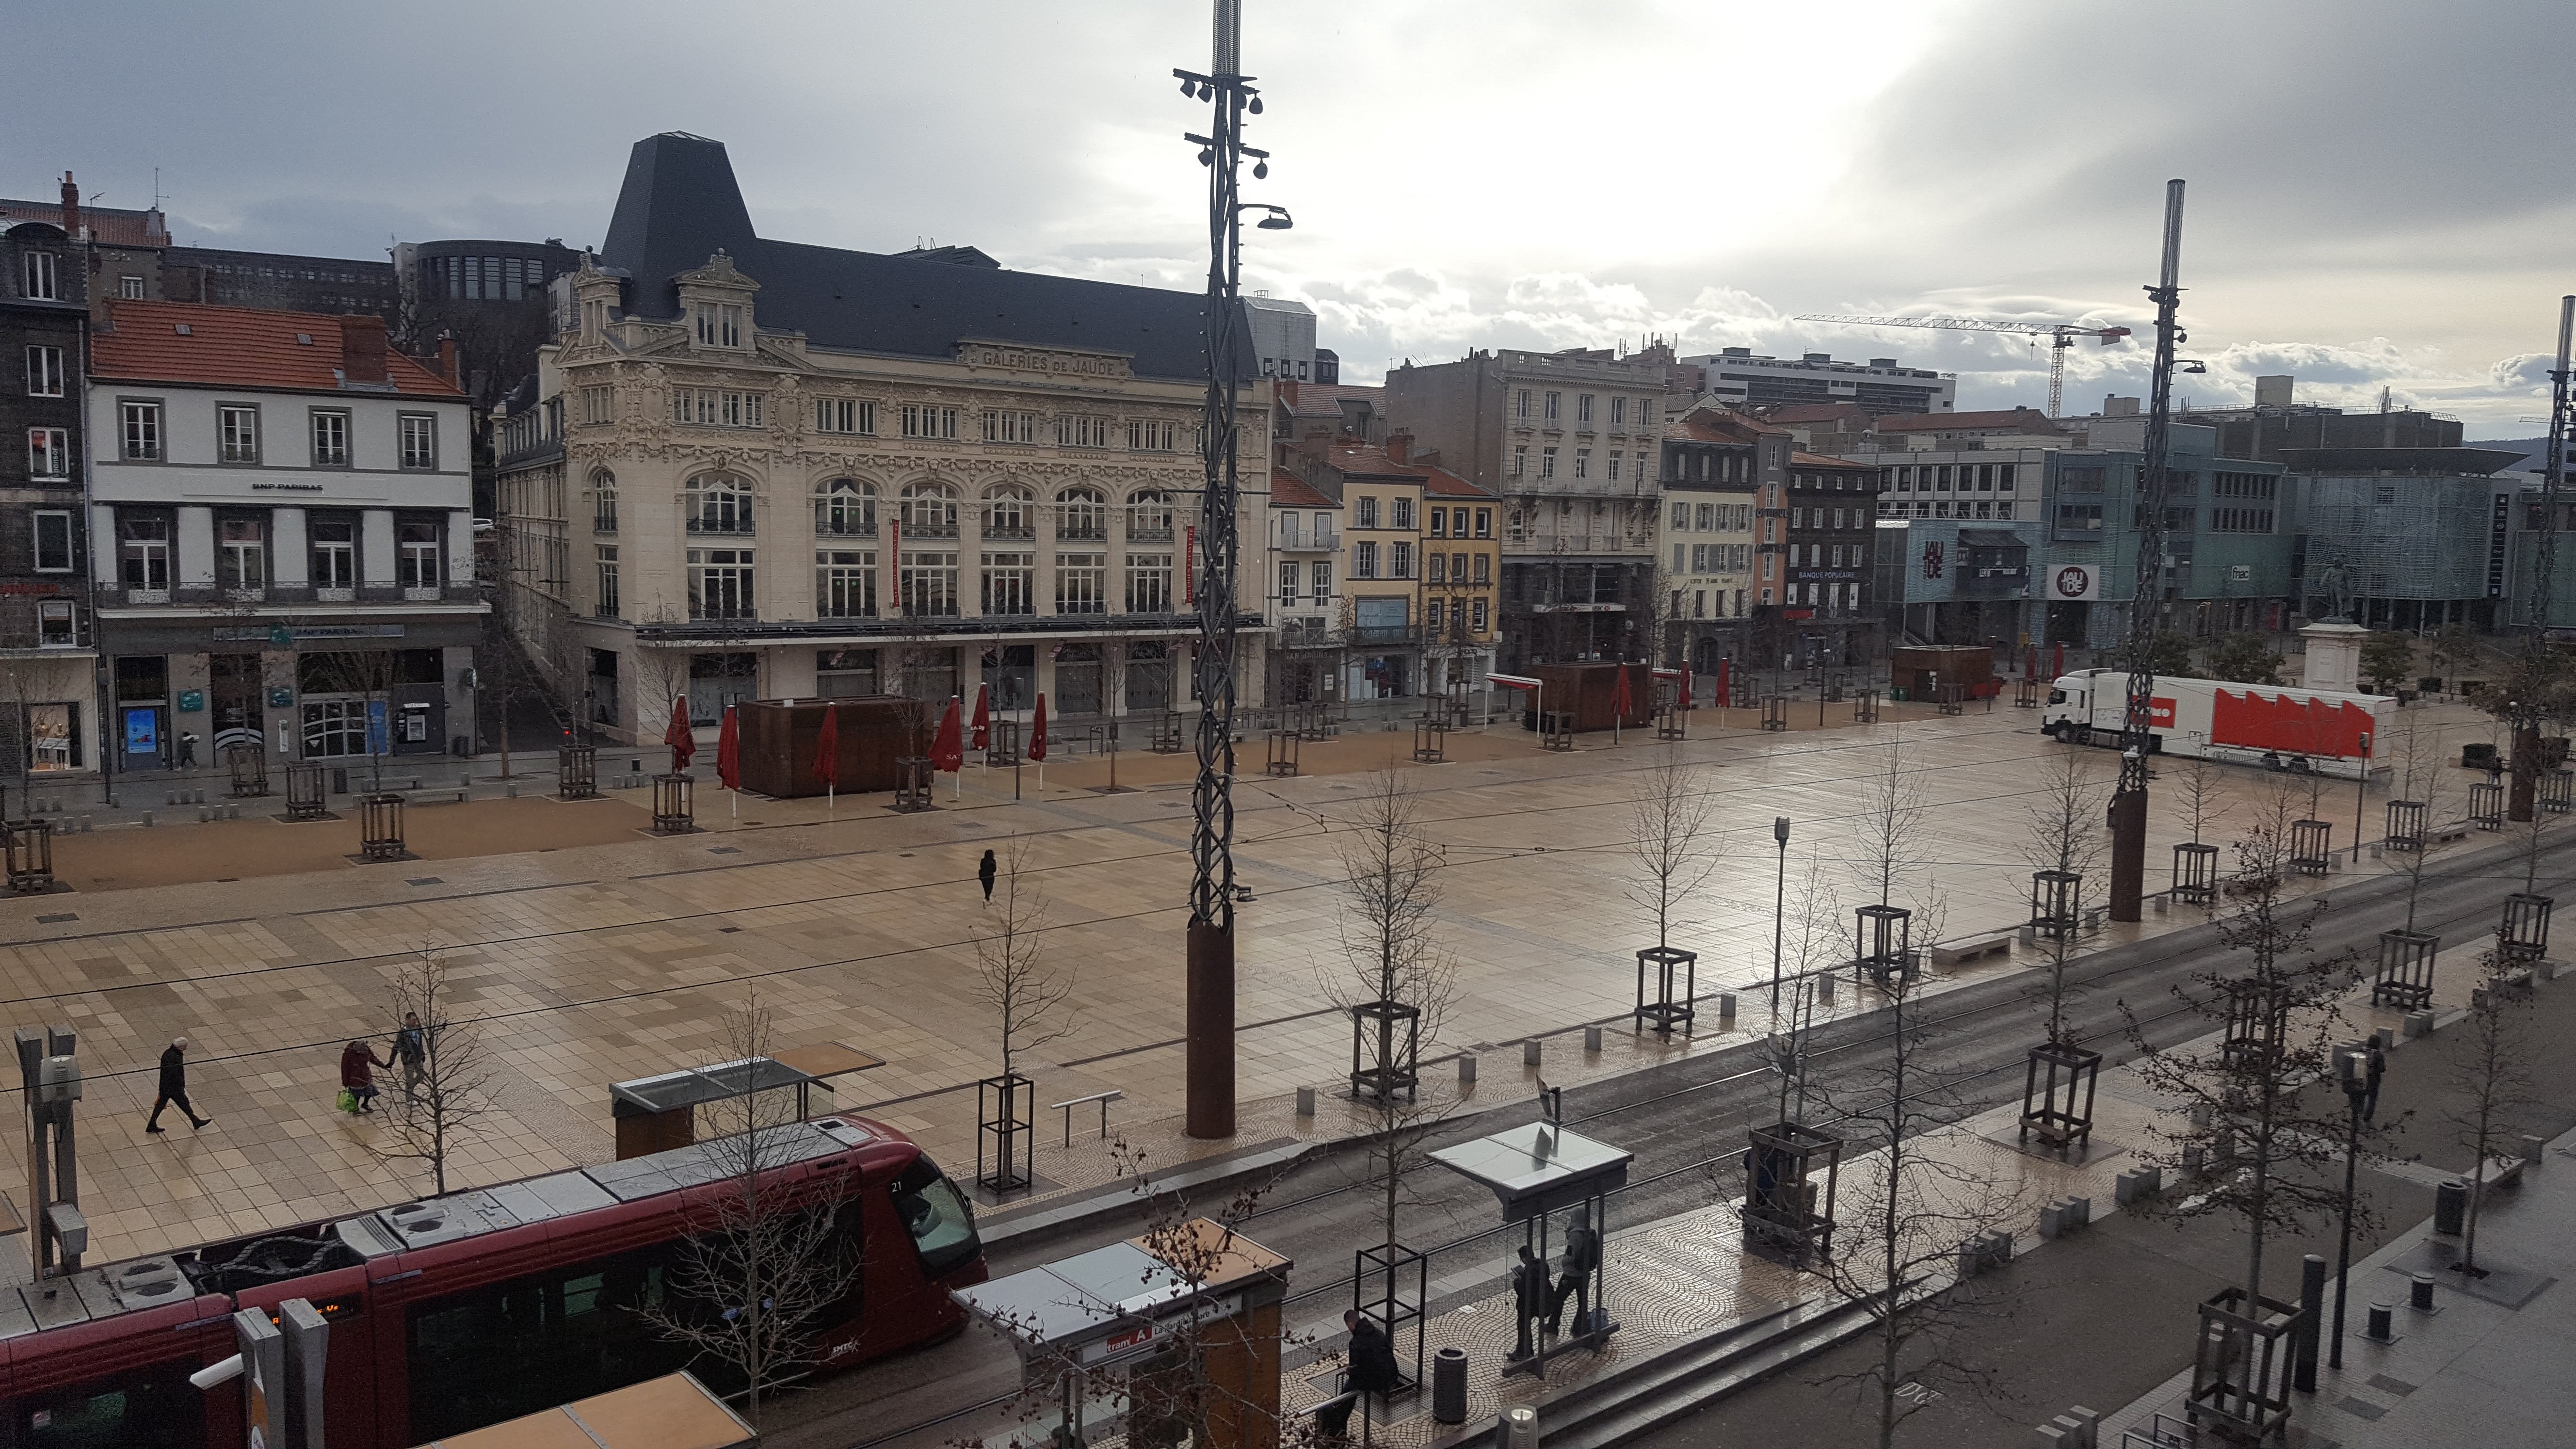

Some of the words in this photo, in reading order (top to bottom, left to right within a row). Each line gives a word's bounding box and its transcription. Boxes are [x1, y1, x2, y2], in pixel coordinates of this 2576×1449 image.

[984, 352, 1048, 370] GALERIES
[1053, 361, 1067, 371] DE
[1072, 360, 1114, 375] JAUDE
[2233, 567, 2249, 579] fnac
[892, 1181, 901, 1192] 21
[1107, 1338, 1129, 1352] tram
[1136, 1329, 1146, 1342] A
[833, 1342, 852, 1353] SMTC
